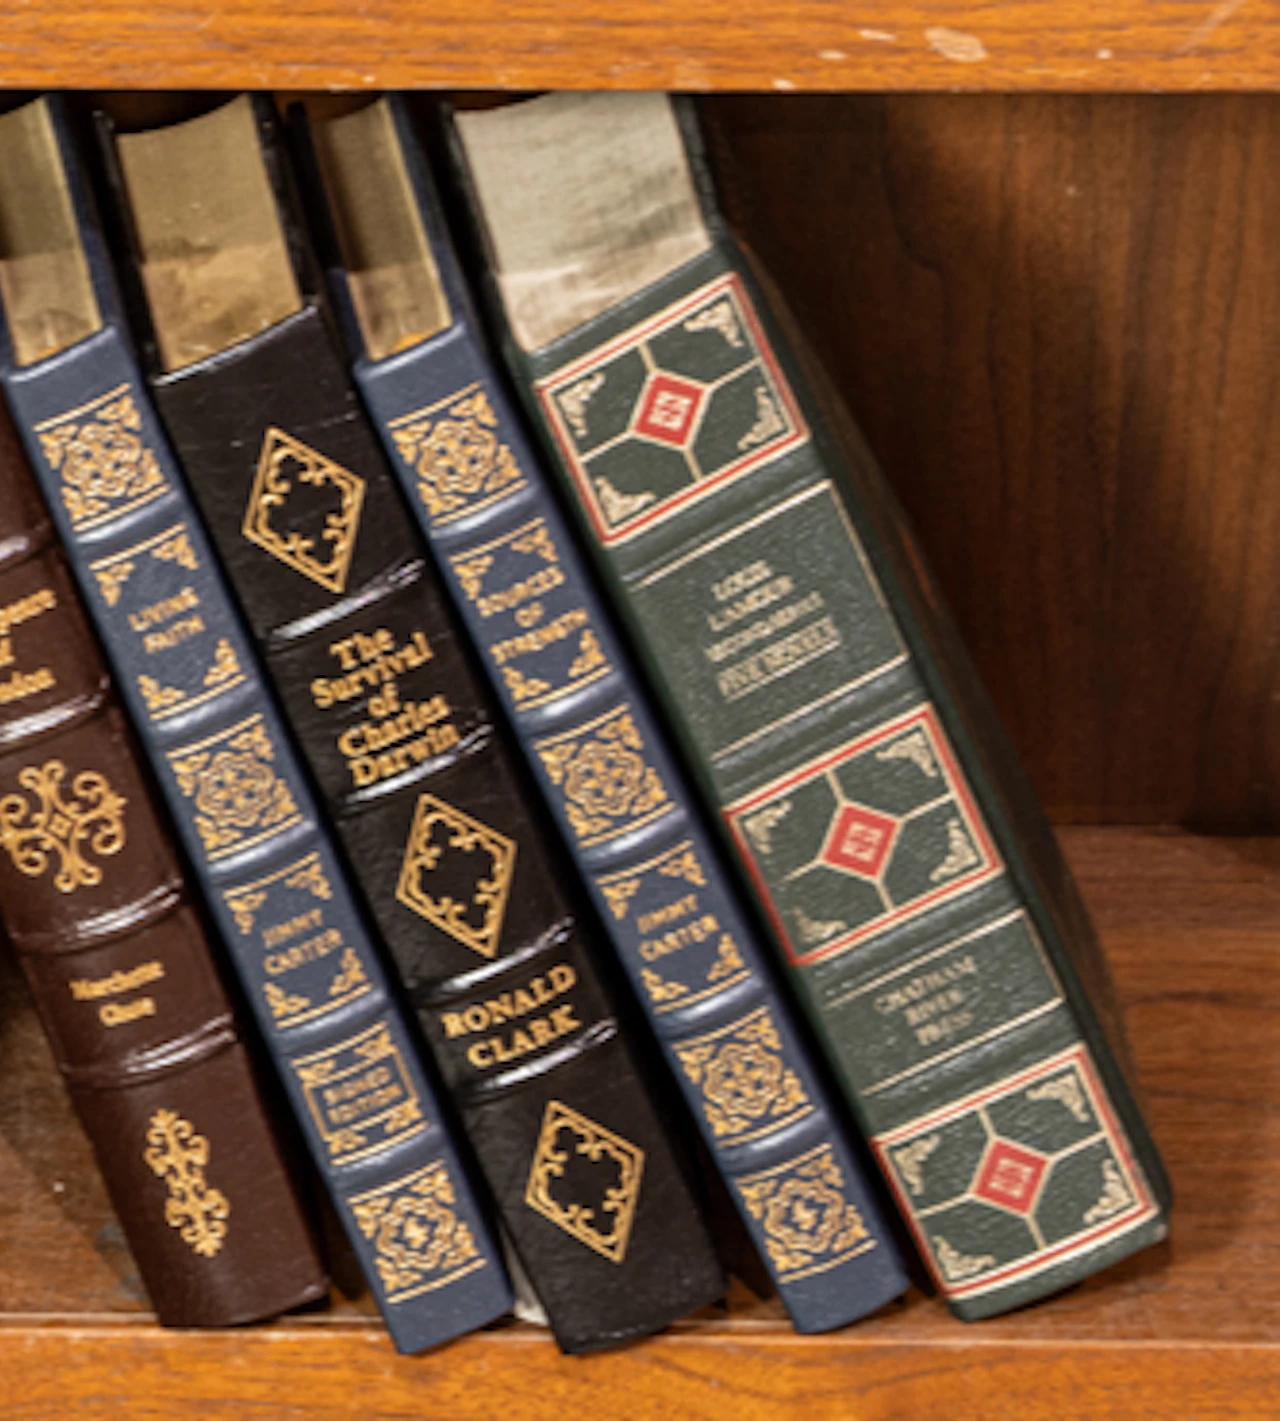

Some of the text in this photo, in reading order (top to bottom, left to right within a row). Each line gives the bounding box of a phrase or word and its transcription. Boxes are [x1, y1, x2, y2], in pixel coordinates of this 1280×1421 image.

[128, 586, 200, 632] LIVING
[476, 565, 565, 618] SOURCES
[514, 601, 544, 628] OF
[143, 616, 206, 653] FAITH
[330, 628, 394, 670] The
[489, 608, 588, 665] STRENGTH
[310, 631, 434, 709] Survival
[368, 682, 400, 717] of
[339, 694, 450, 757] Charles
[348, 724, 461, 786] Darwin
[262, 908, 322, 949] JIMMY
[637, 893, 698, 934] JIMMY
[264, 928, 344, 975] CARTER
[639, 914, 720, 961] CARTER
[441, 964, 577, 1038] RONALD
[467, 1004, 582, 1067] CLARK
